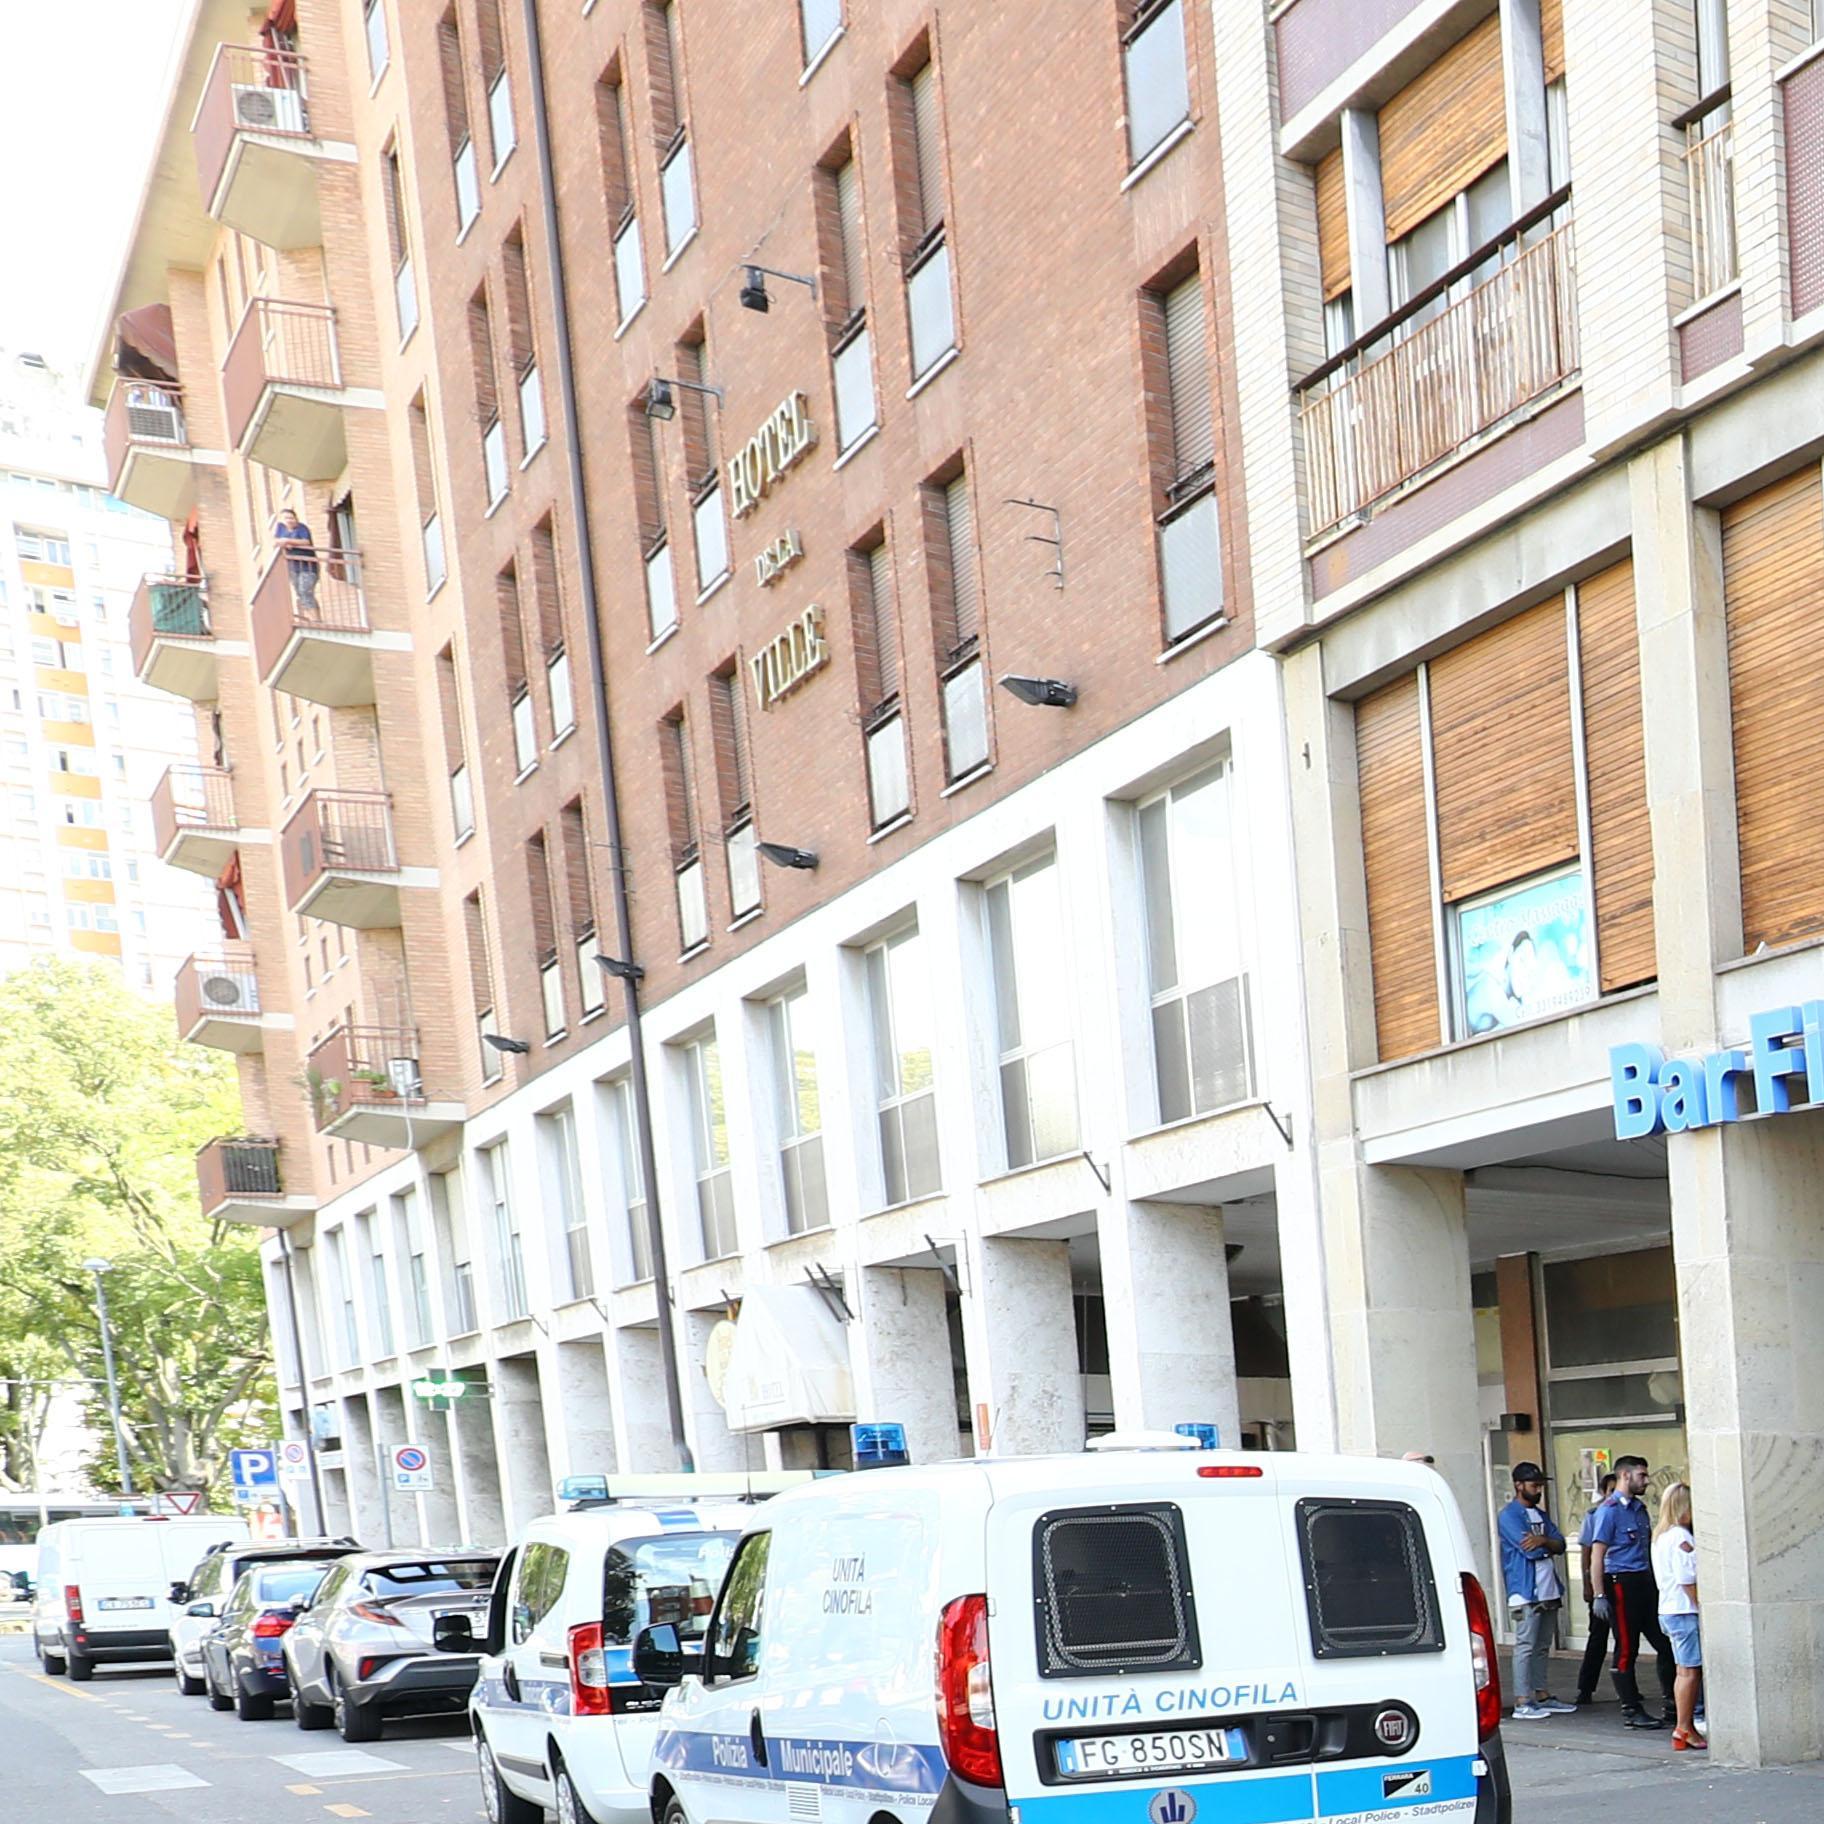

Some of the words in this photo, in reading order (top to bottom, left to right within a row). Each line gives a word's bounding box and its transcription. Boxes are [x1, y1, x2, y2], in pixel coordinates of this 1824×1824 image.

[728, 389, 818, 519] HOTEL
[749, 604, 831, 713] VILLE
[1608, 1042, 1747, 1140] Bar
[239, 1453, 270, 1486] P
[832, 1551, 866, 1582] UNITÀ
[822, 1588, 872, 1615] CINOFILA
[1043, 1688, 1142, 1721] UNITÀ
[1155, 1681, 1298, 1713] CINOFILA
[1382, 1719, 1405, 1737] FIAT
[711, 1735, 749, 1769] Polizia
[779, 1739, 853, 1784] Municipale
[1079, 1740, 1120, 1769] FG
[1130, 1731, 1226, 1763] 850SN
[1415, 1782, 1430, 1795] 40
[1364, 1809, 1401, 1823] Police
[1411, 1798, 1476, 1818] Stadtpolizei
